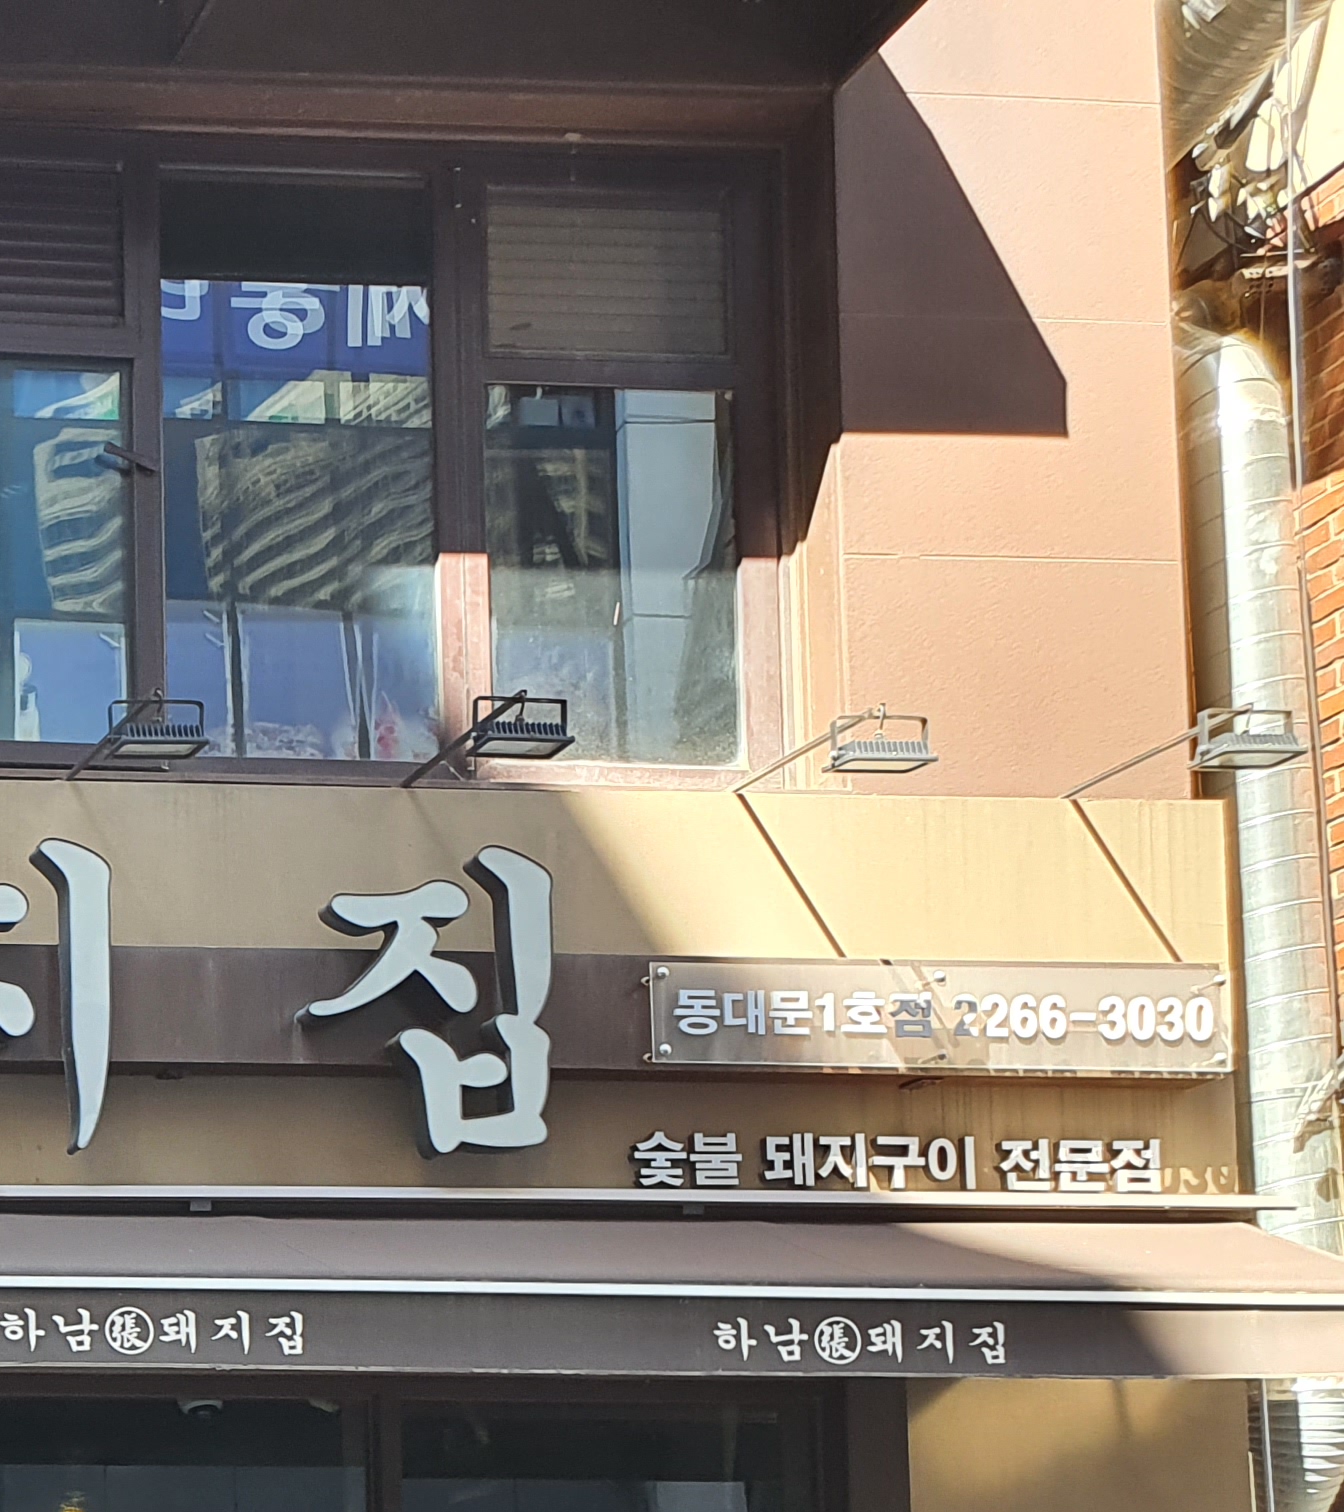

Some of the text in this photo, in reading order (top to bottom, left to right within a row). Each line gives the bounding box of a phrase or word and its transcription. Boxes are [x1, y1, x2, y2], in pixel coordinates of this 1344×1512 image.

[674, 988, 1214, 1044] 동대문1호점 2266-3030
[632, 1130, 1164, 1194] 숯불 돼지구이 전문점
